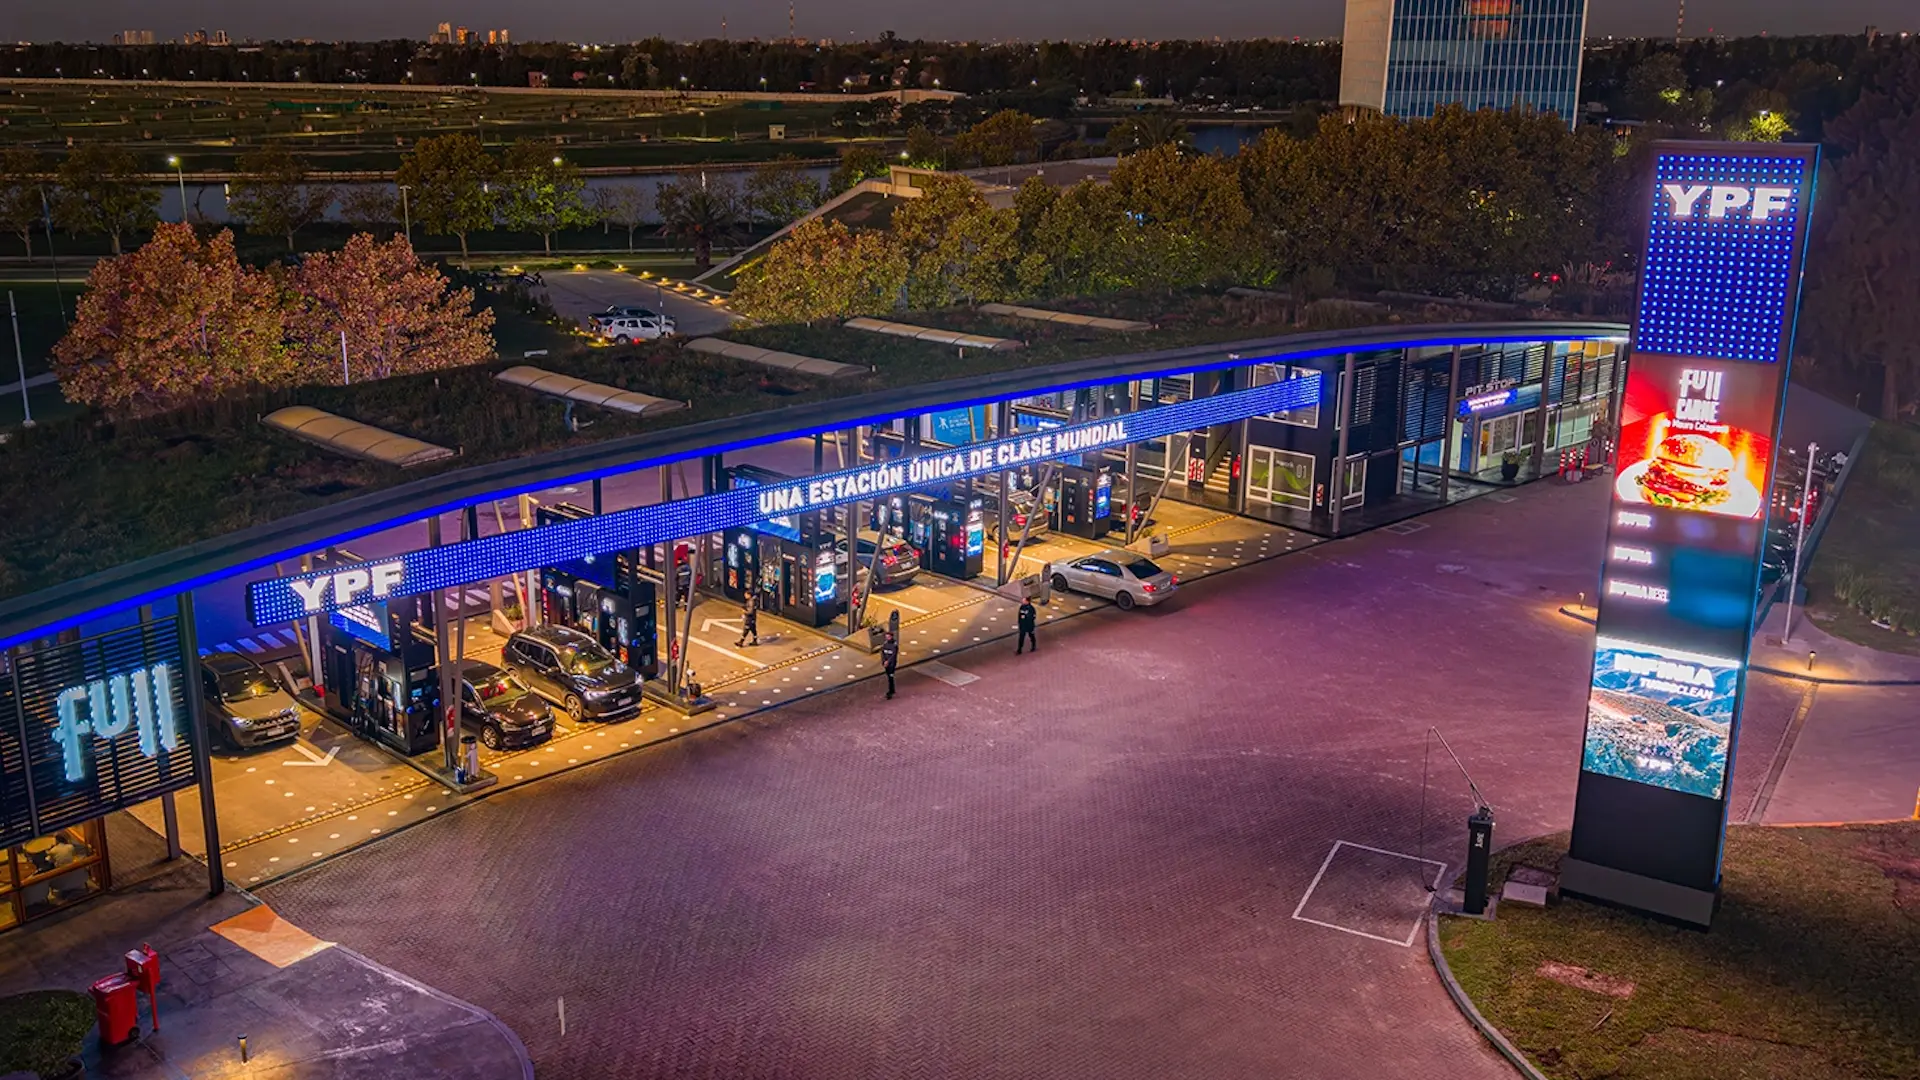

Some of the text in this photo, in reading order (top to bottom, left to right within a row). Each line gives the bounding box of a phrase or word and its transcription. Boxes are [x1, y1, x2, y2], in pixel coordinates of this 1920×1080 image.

[1663, 184, 1791, 220] YPF
[1465, 385, 1484, 396] PIT
[760, 421, 1127, 514] UNA ESTACIÓN ÚNICA DE CLASE MUNDIAL
[290, 561, 402, 611] YPF
